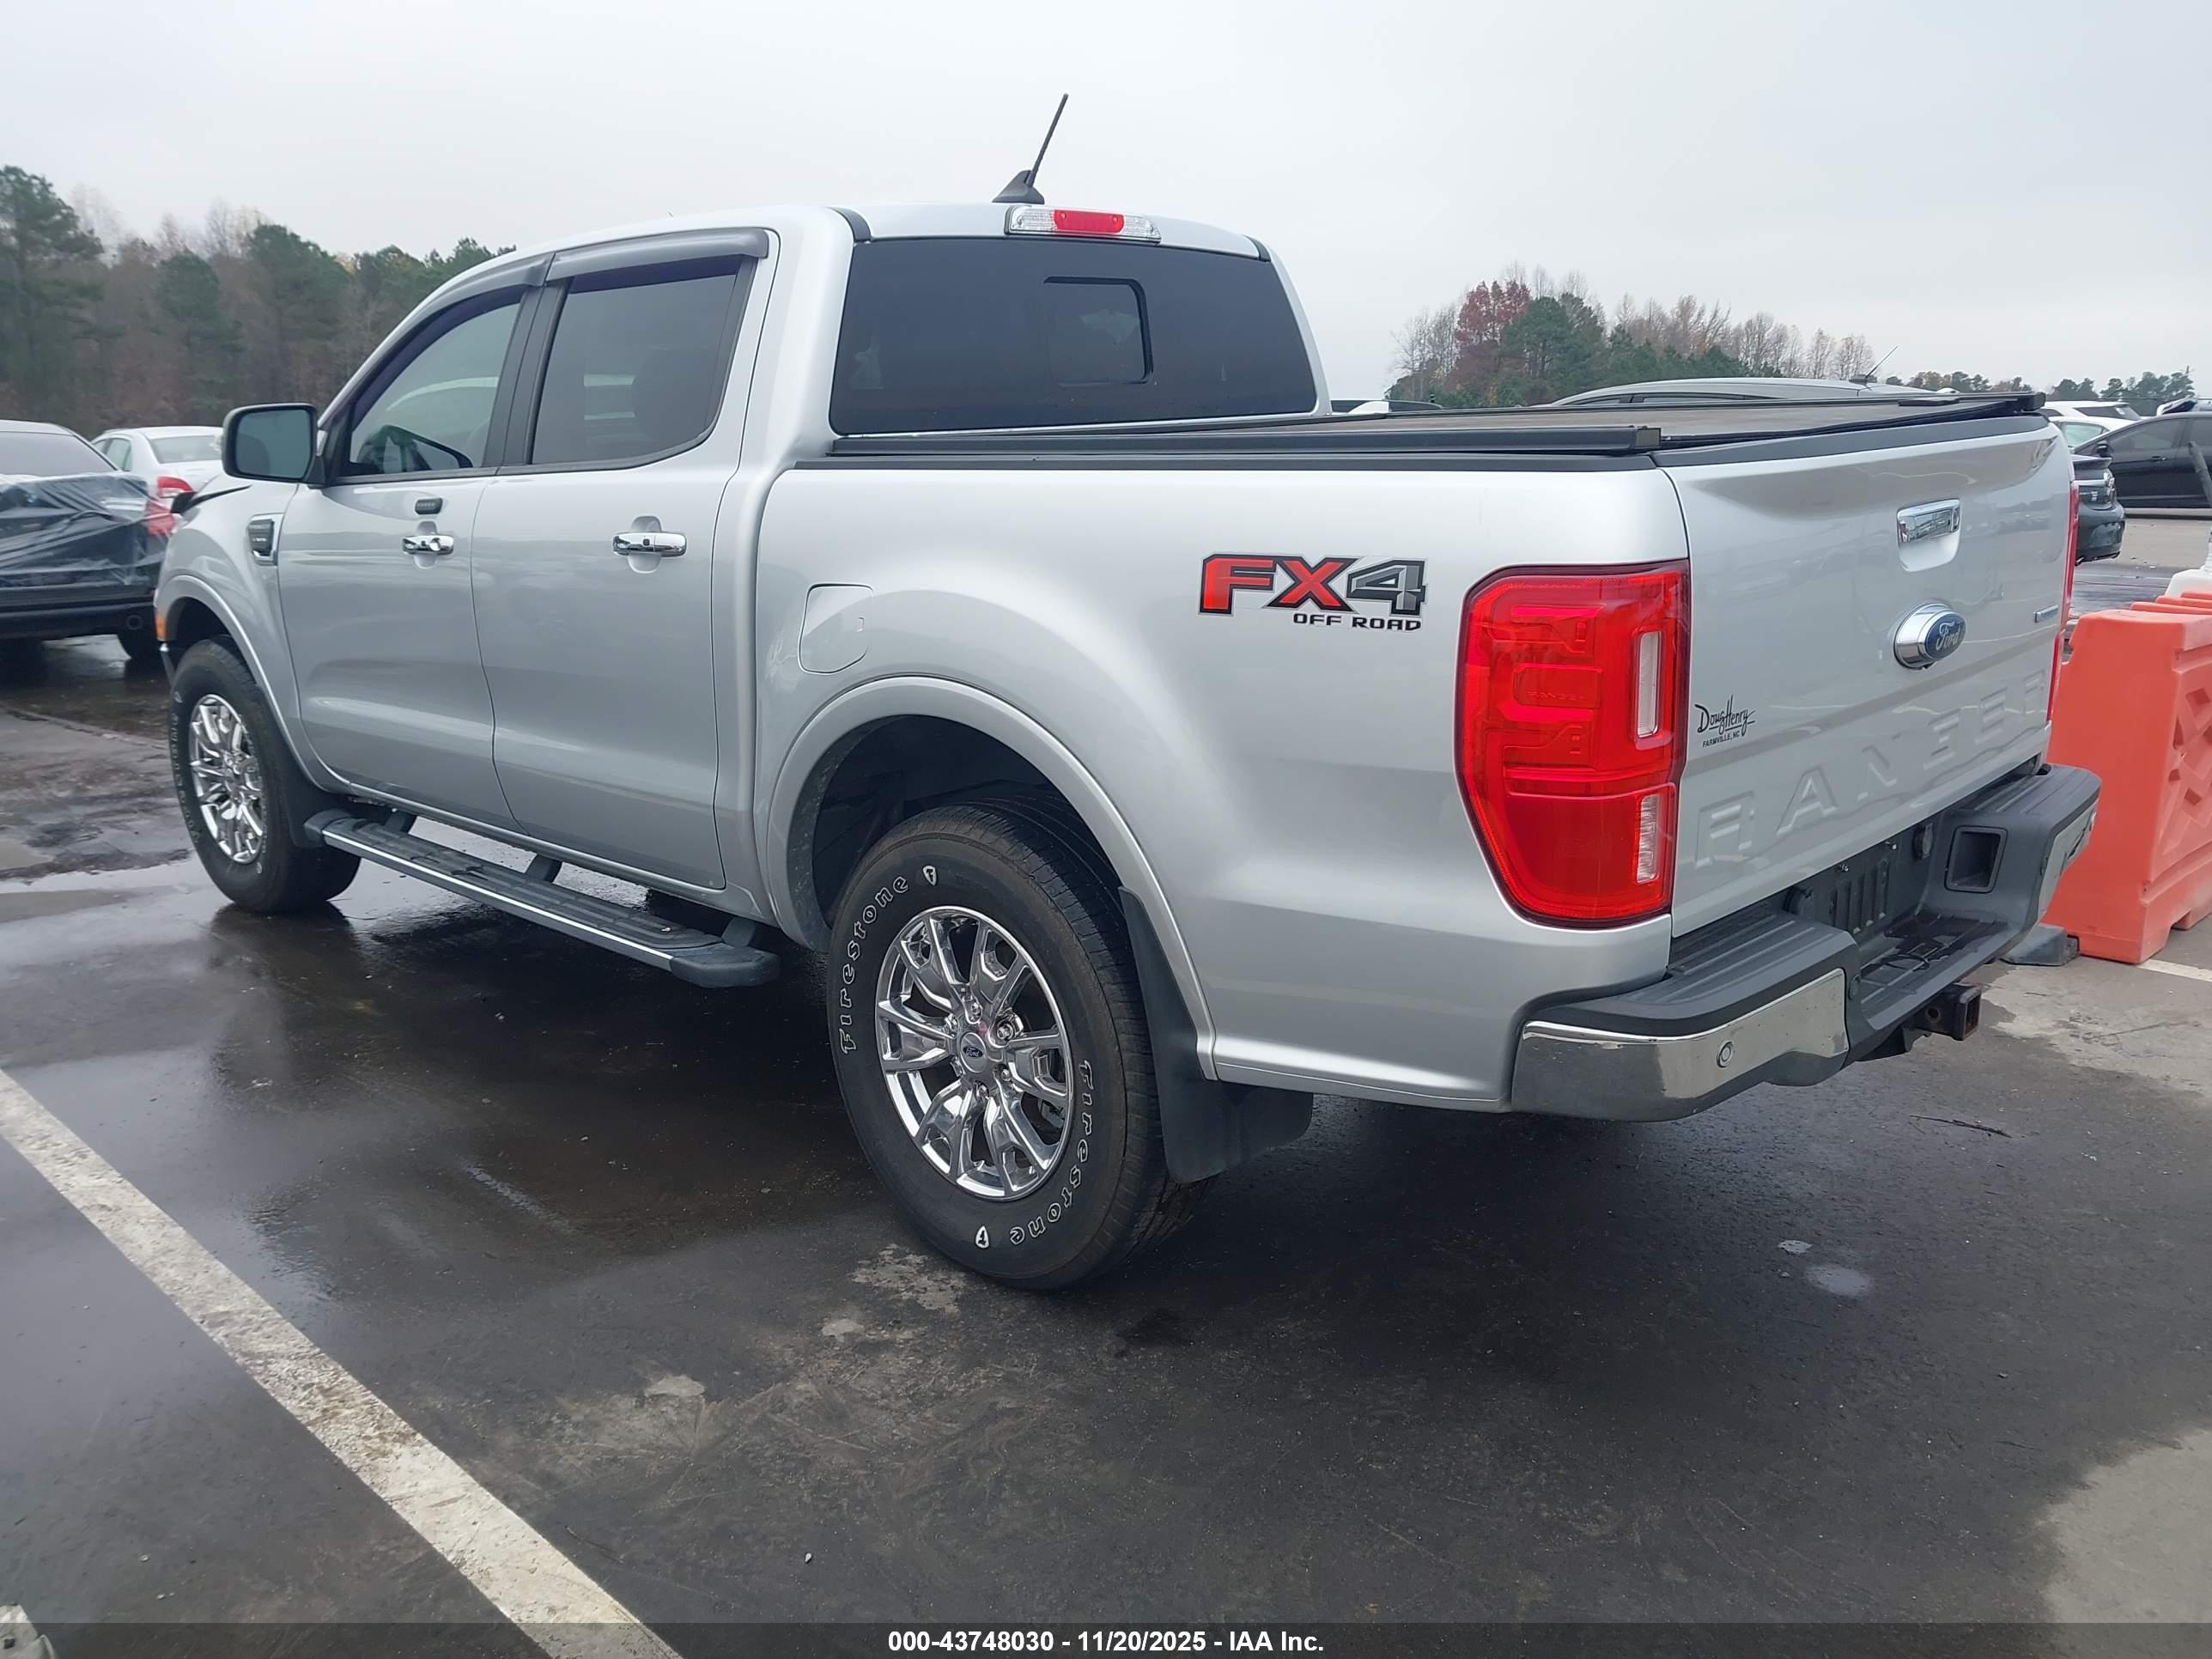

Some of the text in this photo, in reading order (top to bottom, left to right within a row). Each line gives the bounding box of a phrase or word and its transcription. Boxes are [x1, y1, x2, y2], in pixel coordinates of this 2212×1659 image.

[1199, 553, 1426, 617] FX4
[1292, 612, 1422, 632] OFF ROAD
[1935, 620, 1962, 651] Ford
[1694, 694, 1757, 737] Doug Henry
[1695, 669, 2047, 867] RANGER
[839, 876, 908, 1054] Firestone
[1010, 1060, 1094, 1245] Firestone
